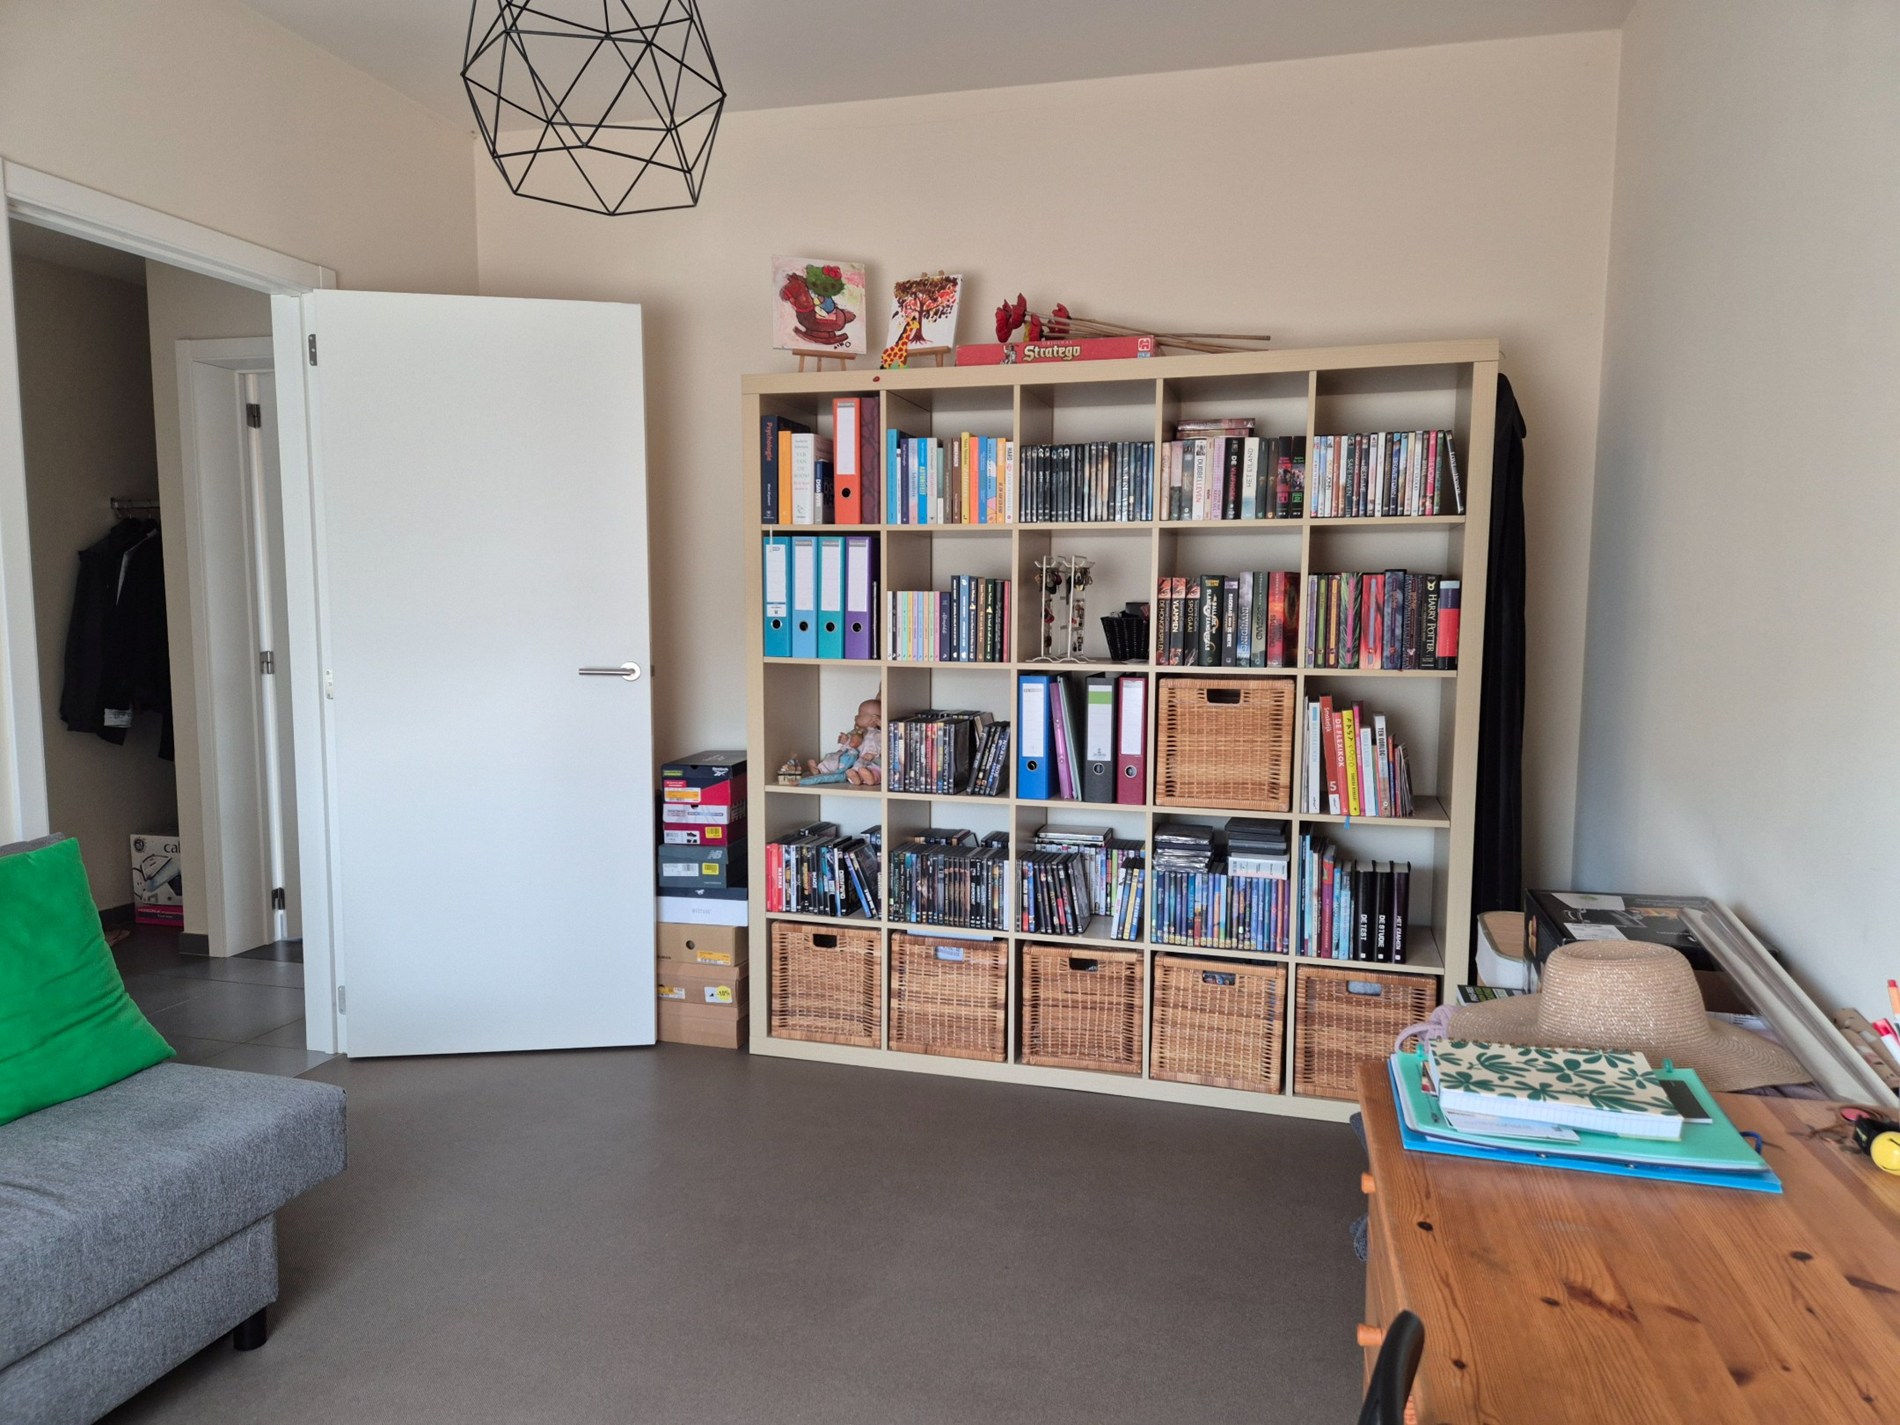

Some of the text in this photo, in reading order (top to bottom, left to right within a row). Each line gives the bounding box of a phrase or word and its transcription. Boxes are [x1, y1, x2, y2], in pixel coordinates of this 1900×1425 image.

[1023, 345, 1081, 361] Stratego
[765, 422, 774, 461] Psychologie
[1231, 455, 1237, 465] DE
[1195, 458, 1203, 503] DUBBELLEVEN
[1159, 600, 1165, 608] DE
[1240, 607, 1249, 652] INWIJDING
[1426, 594, 1437, 652] HARRY POTTER
[1324, 707, 1332, 732] Smakelijk
[998, 740, 1007, 760] NOAH
[1335, 719, 1344, 767] DE FLEXIKOK
[1378, 738, 1386, 756] OORLOG
[1330, 781, 1337, 791] 5
[1360, 914, 1367, 923] DE
[1379, 915, 1385, 923] DE
